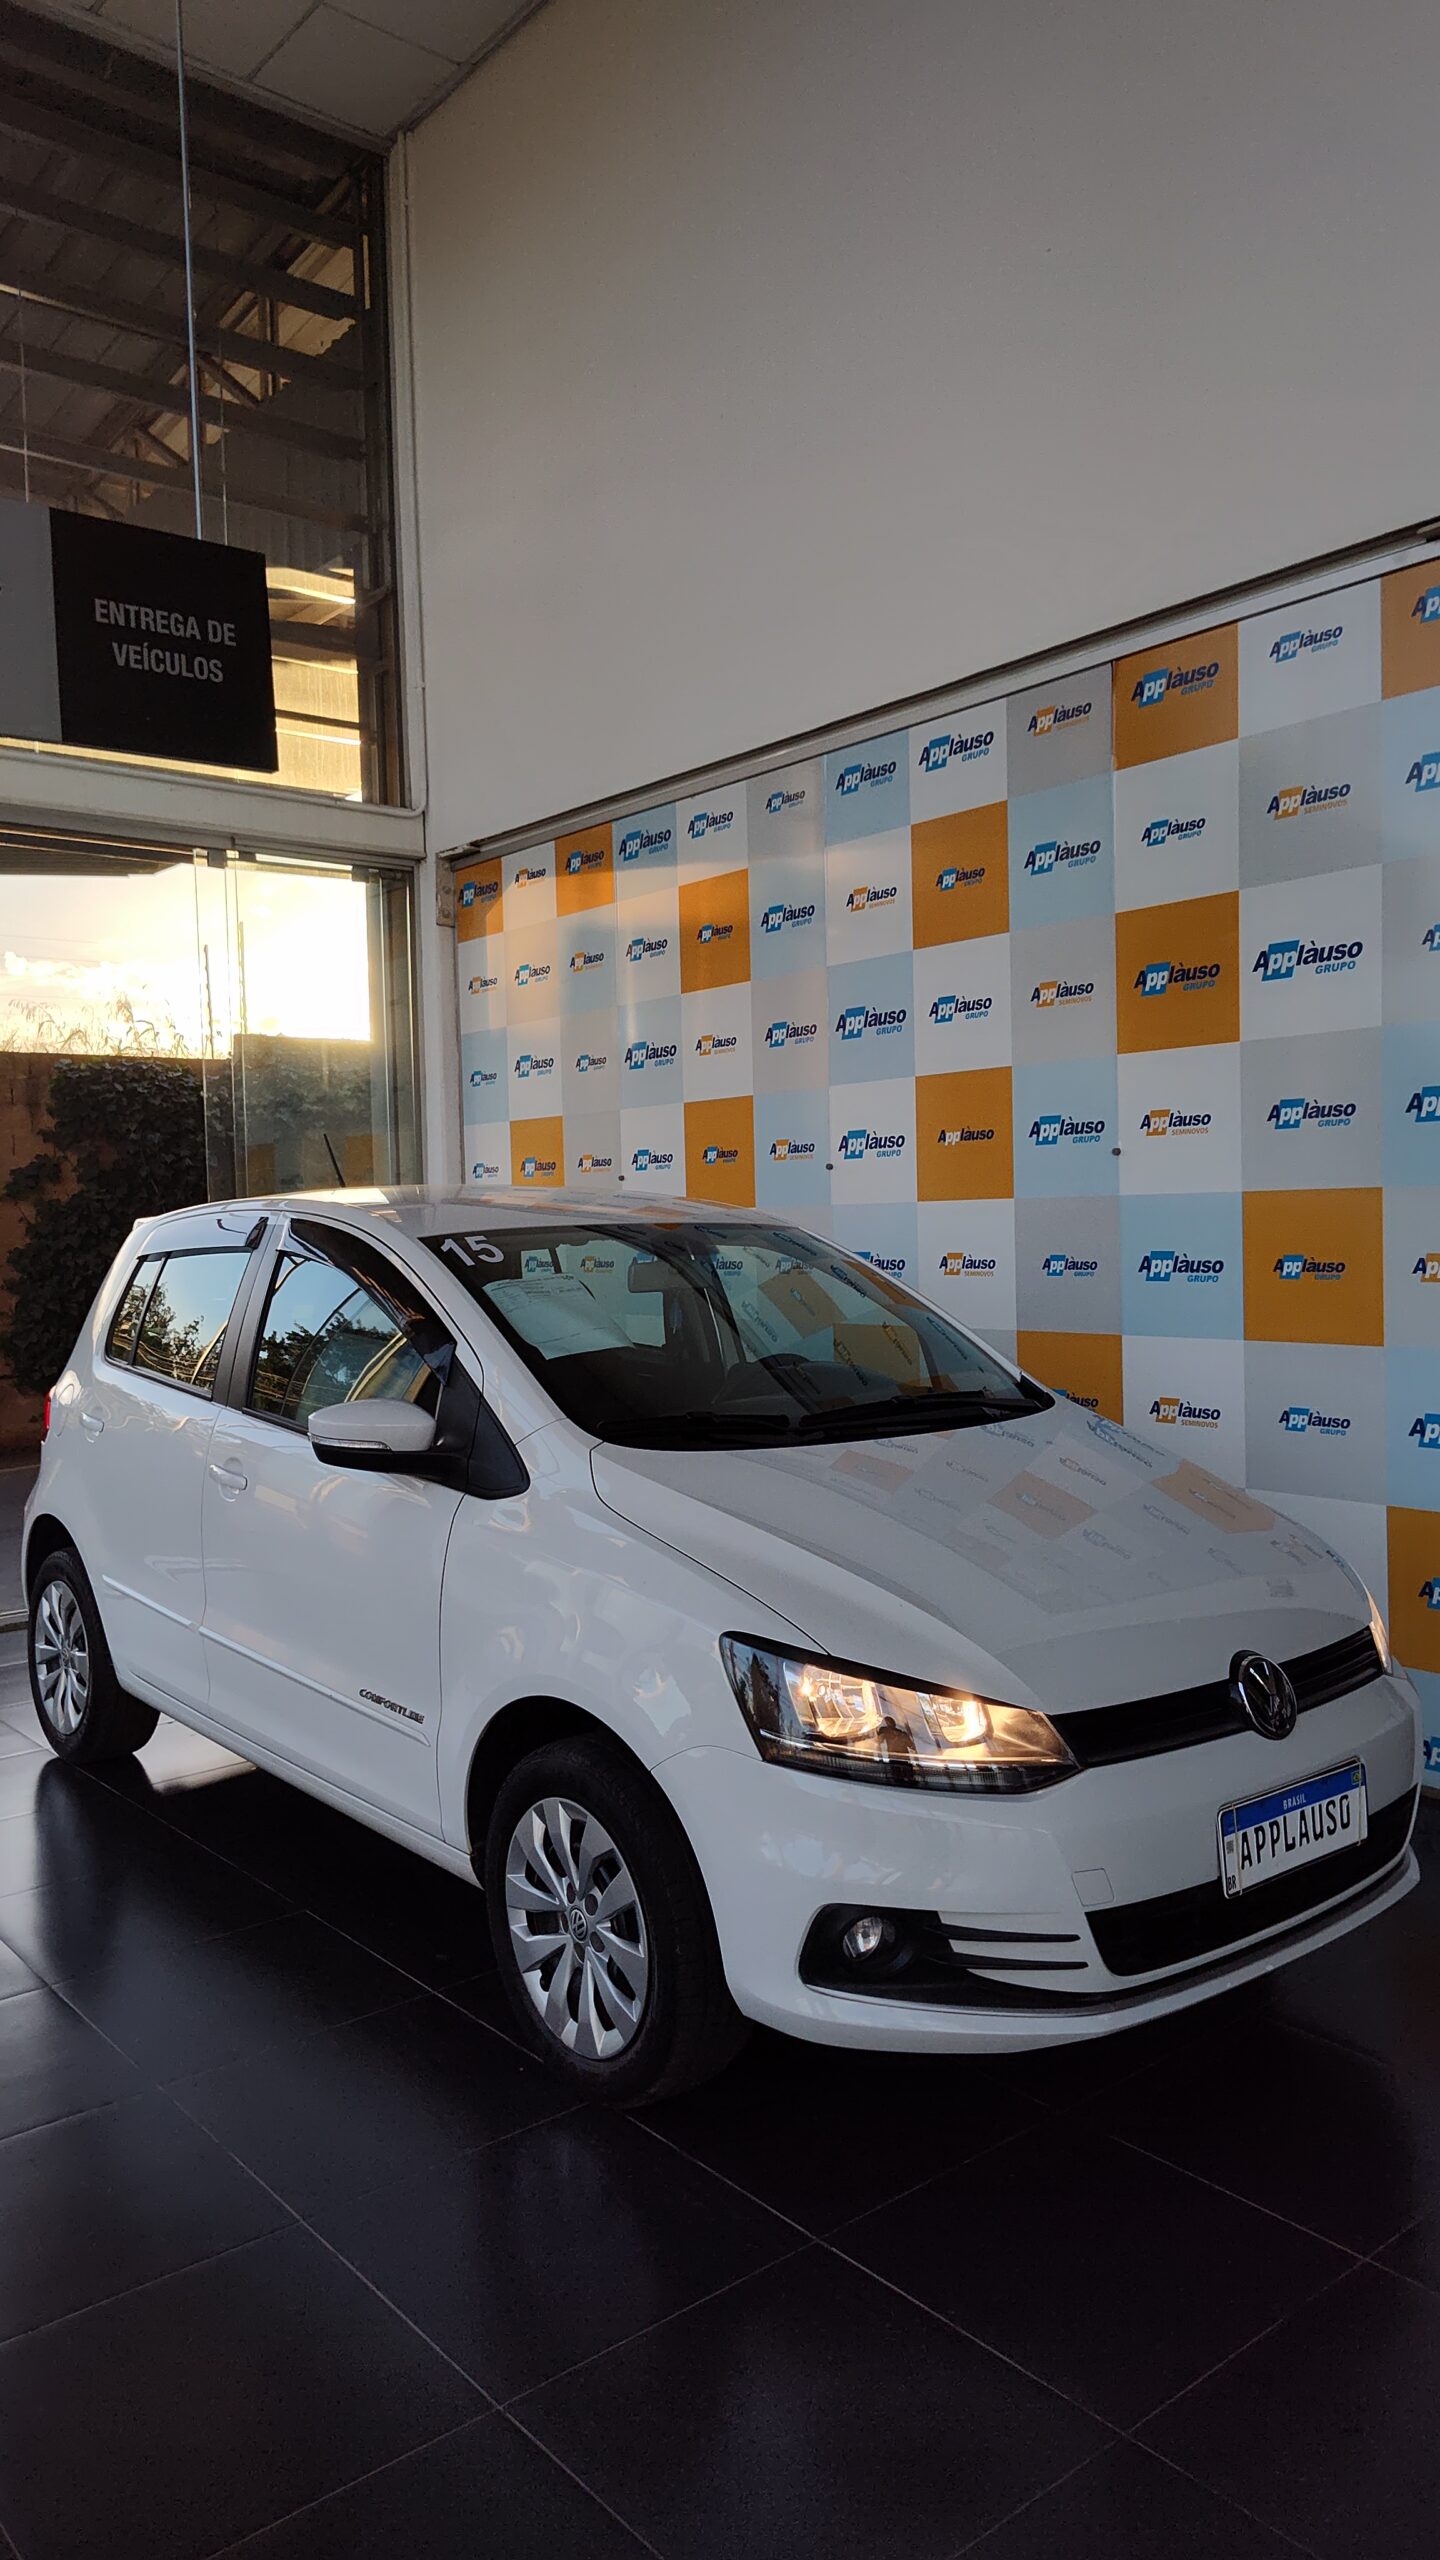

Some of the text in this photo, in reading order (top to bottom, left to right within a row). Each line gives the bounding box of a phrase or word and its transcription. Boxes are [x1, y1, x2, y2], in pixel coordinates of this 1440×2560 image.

[94, 598, 237, 647] ENTREGA DE
[1269, 625, 1343, 663] Applàuso
[1311, 640, 1339, 652] GRUPO
[112, 642, 224, 683] VEÍCULOS
[1131, 661, 1219, 708] Applàuso
[1180, 679, 1214, 696] GRUPO
[1027, 702, 1092, 737] Applàuso
[918, 730, 994, 772] Applàuso
[961, 747, 990, 762] GRUPO
[835, 760, 896, 796] Applàuso
[870, 775, 893, 788] GRUPO
[1266, 783, 1351, 821] Applàuso
[688, 811, 733, 839] Applàuso
[1141, 817, 1206, 847] Applàuso
[1178, 830, 1202, 841] GRUPO
[619, 828, 671, 861] Applàuso
[1023, 839, 1101, 876] Applàuso
[1067, 855, 1097, 869] GRUPO
[846, 885, 897, 912] Applàuso
[761, 903, 815, 933] Applàuso
[626, 937, 668, 962] Applàuso
[1252, 939, 1363, 981] Applàuso
[1133, 961, 1220, 997] Applàuso
[1314, 960, 1356, 975] GRUPO
[1030, 980, 1095, 1008] Applàuso
[1182, 979, 1216, 992] GRUPO
[835, 1006, 906, 1040] Applàuso
[929, 995, 992, 1024] Applàuso
[965, 1010, 989, 1020] GRUPO
[765, 1021, 817, 1048] Applàuso
[875, 1025, 902, 1036] GRUPO
[624, 1041, 677, 1070] Applàuso
[654, 1057, 674, 1067] GRUPO
[1139, 1109, 1212, 1137] Applàuso
[1266, 1097, 1357, 1130] Applàuso
[1316, 1117, 1351, 1128] GRUPO
[937, 1126, 994, 1147] Applàuso
[1028, 1114, 1105, 1146] Applàuso
[1072, 1134, 1101, 1145] GRUPO
[1170, 1126, 1209, 1136] SEMINOVOS
[769, 1138, 815, 1161] Applàuso
[838, 1129, 905, 1160] Applàuso
[876, 1149, 901, 1158] GRUPO
[631, 1149, 673, 1171] Applàuso
[440, 1235, 505, 1266] 15
[866, 1252, 906, 1271] làuso
[938, 1252, 996, 1276] Applàuso
[1042, 1253, 1099, 1277] Applàuso
[1073, 1270, 1095, 1278] GRUPO
[1138, 1250, 1225, 1282] Applàuso
[1186, 1274, 1219, 1283] GRUPO
[1272, 1254, 1346, 1281] Applàuso
[1313, 1272, 1342, 1281] GRUPO
[1149, 1397, 1221, 1424] Applàuso
[1180, 1419, 1219, 1429] SEMINOVOS
[1278, 1406, 1351, 1433] Applàuso
[1319, 1428, 1347, 1436] GRUPO
[1283, 1793, 1307, 1811] BRASIL
[1240, 1794, 1351, 1870] APPLAUSO
[1226, 1875, 1237, 1891] BR
